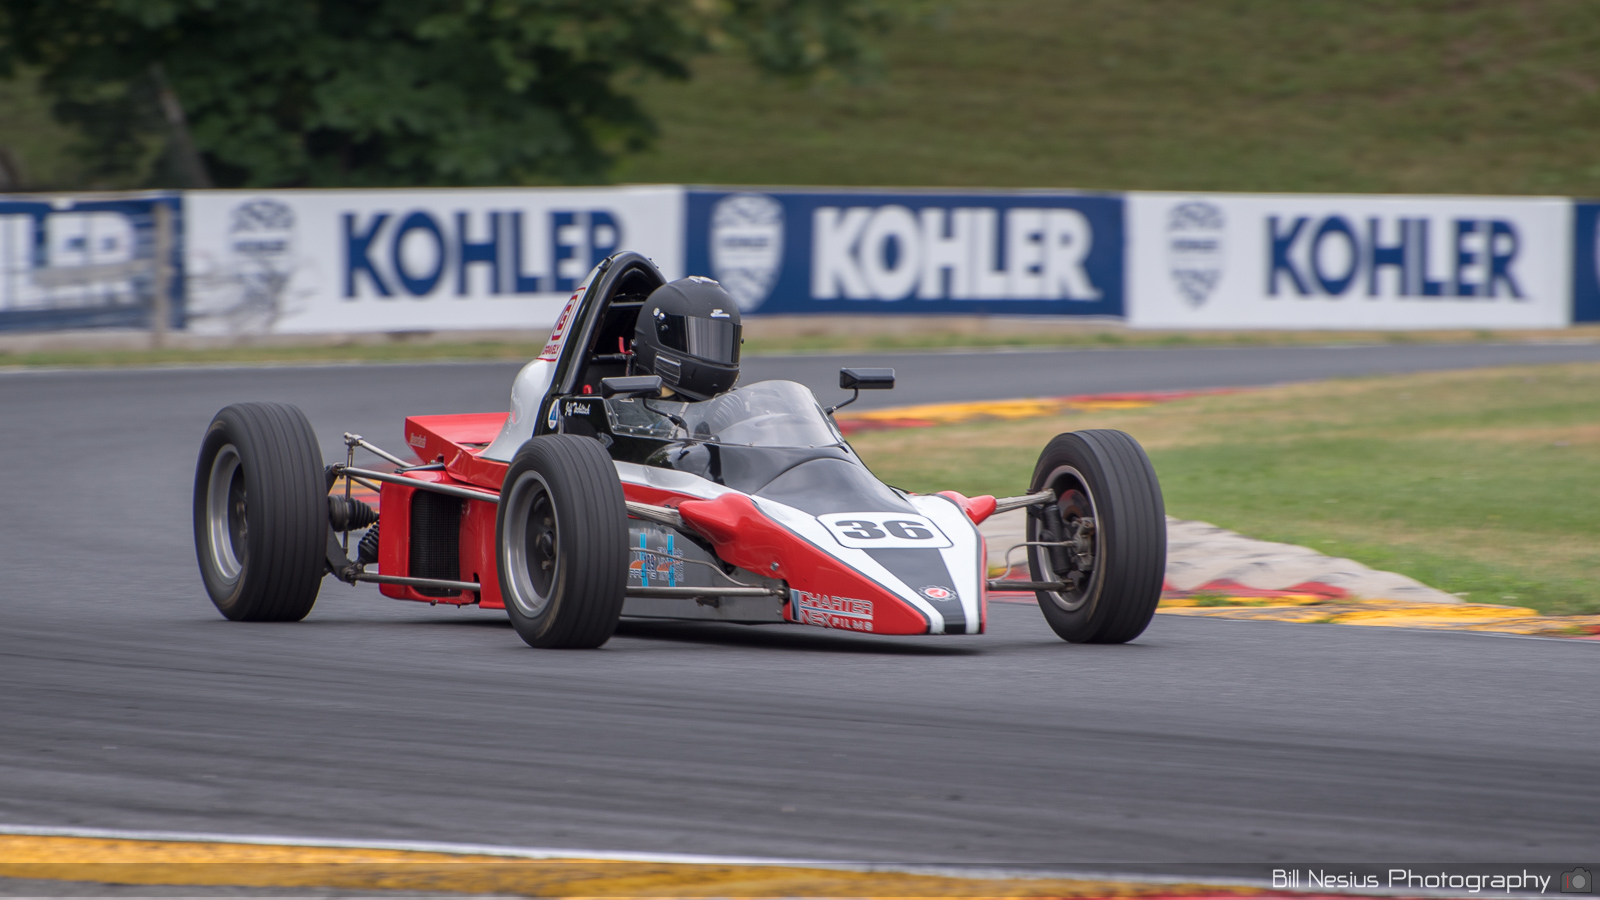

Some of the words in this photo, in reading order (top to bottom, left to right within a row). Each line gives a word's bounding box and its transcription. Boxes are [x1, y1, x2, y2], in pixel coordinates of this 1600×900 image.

[812, 205, 1102, 300] KOHLER
[1266, 214, 1528, 299] KOHLER
[834, 520, 934, 539] 36
[800, 590, 874, 616] CHARTER
[800, 609, 833, 628] NEX
[832, 616, 874, 632] FILMS
